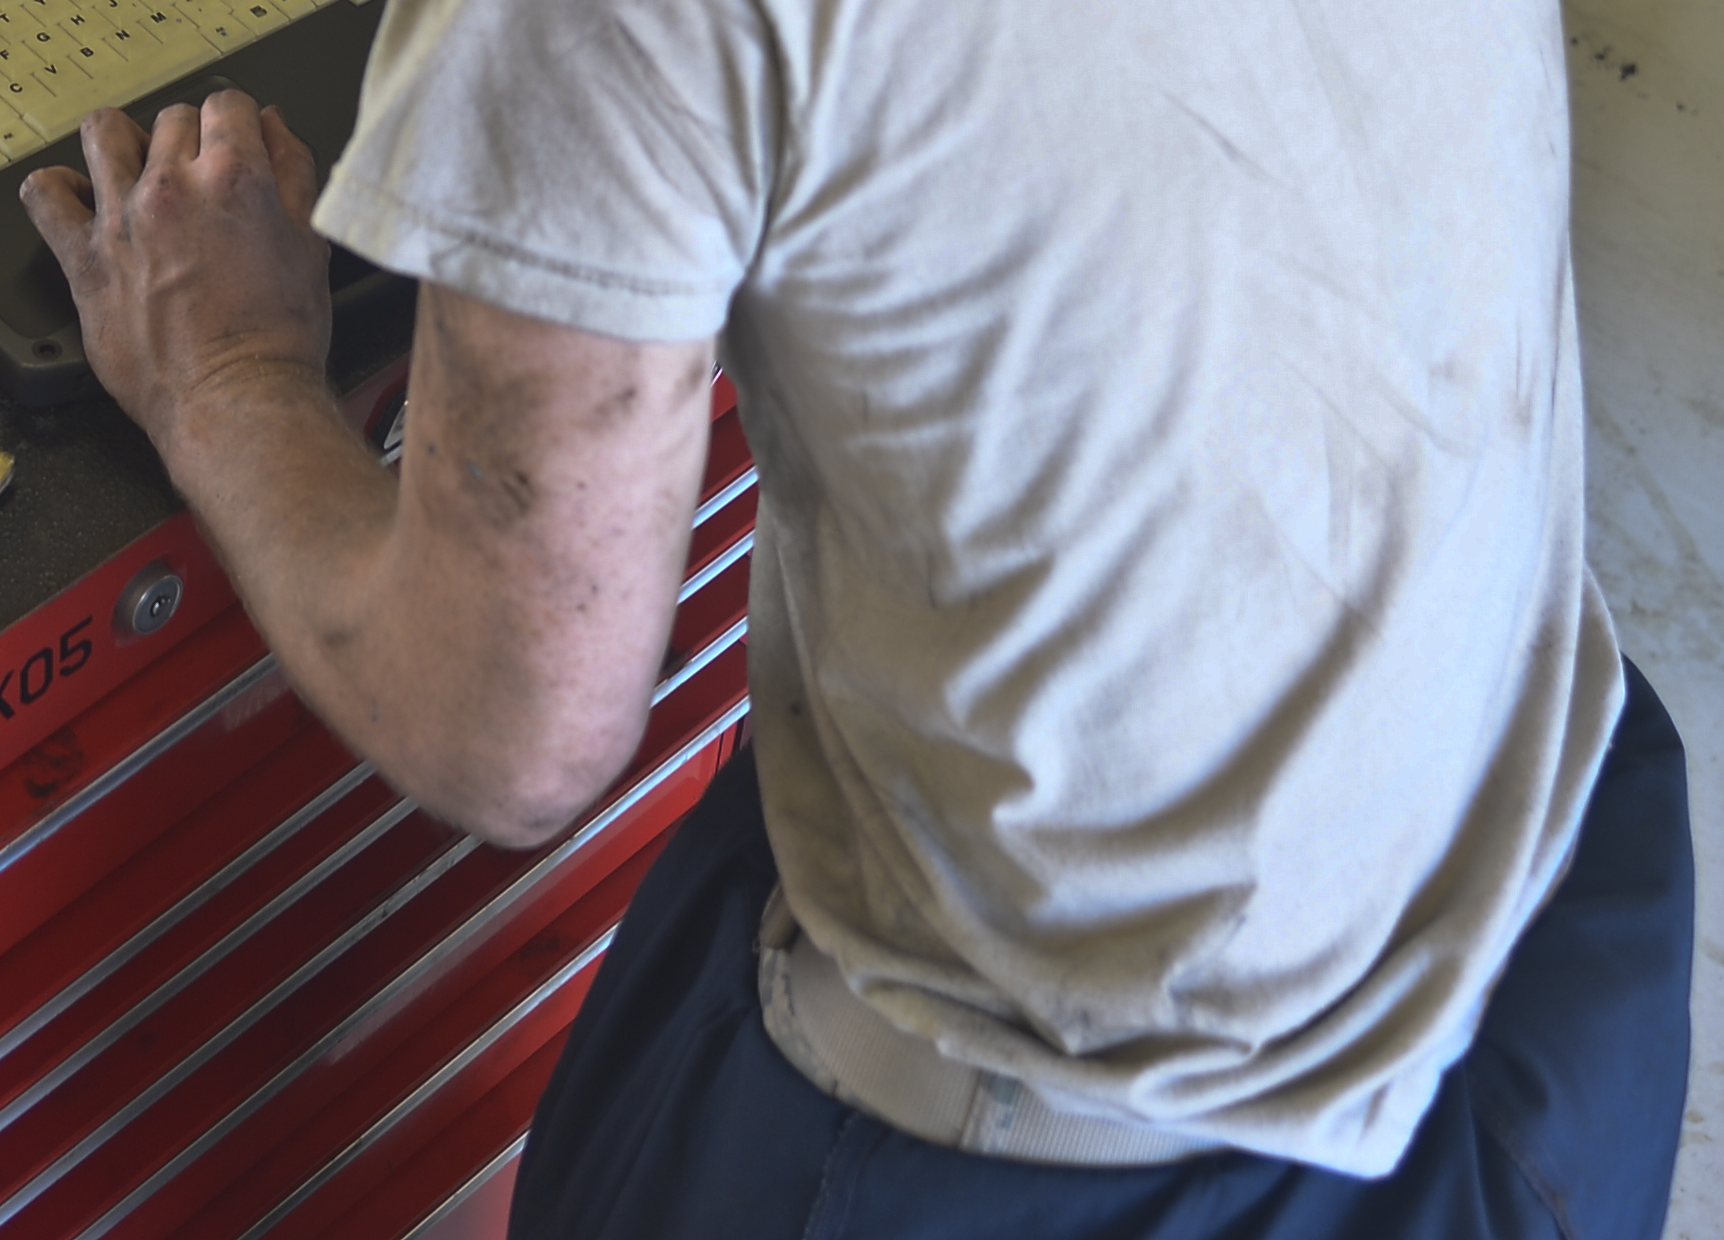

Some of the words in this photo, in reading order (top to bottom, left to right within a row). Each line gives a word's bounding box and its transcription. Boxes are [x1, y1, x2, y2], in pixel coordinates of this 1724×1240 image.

[70, 15, 85, 26] H
[150, 12, 167, 23] M
[36, 32, 51, 42] G
[115, 30, 130, 41] N
[0, 49, 9, 60] F
[80, 47, 94, 57] B
[44, 64, 57, 74] V
[9, 83, 23, 93] C
